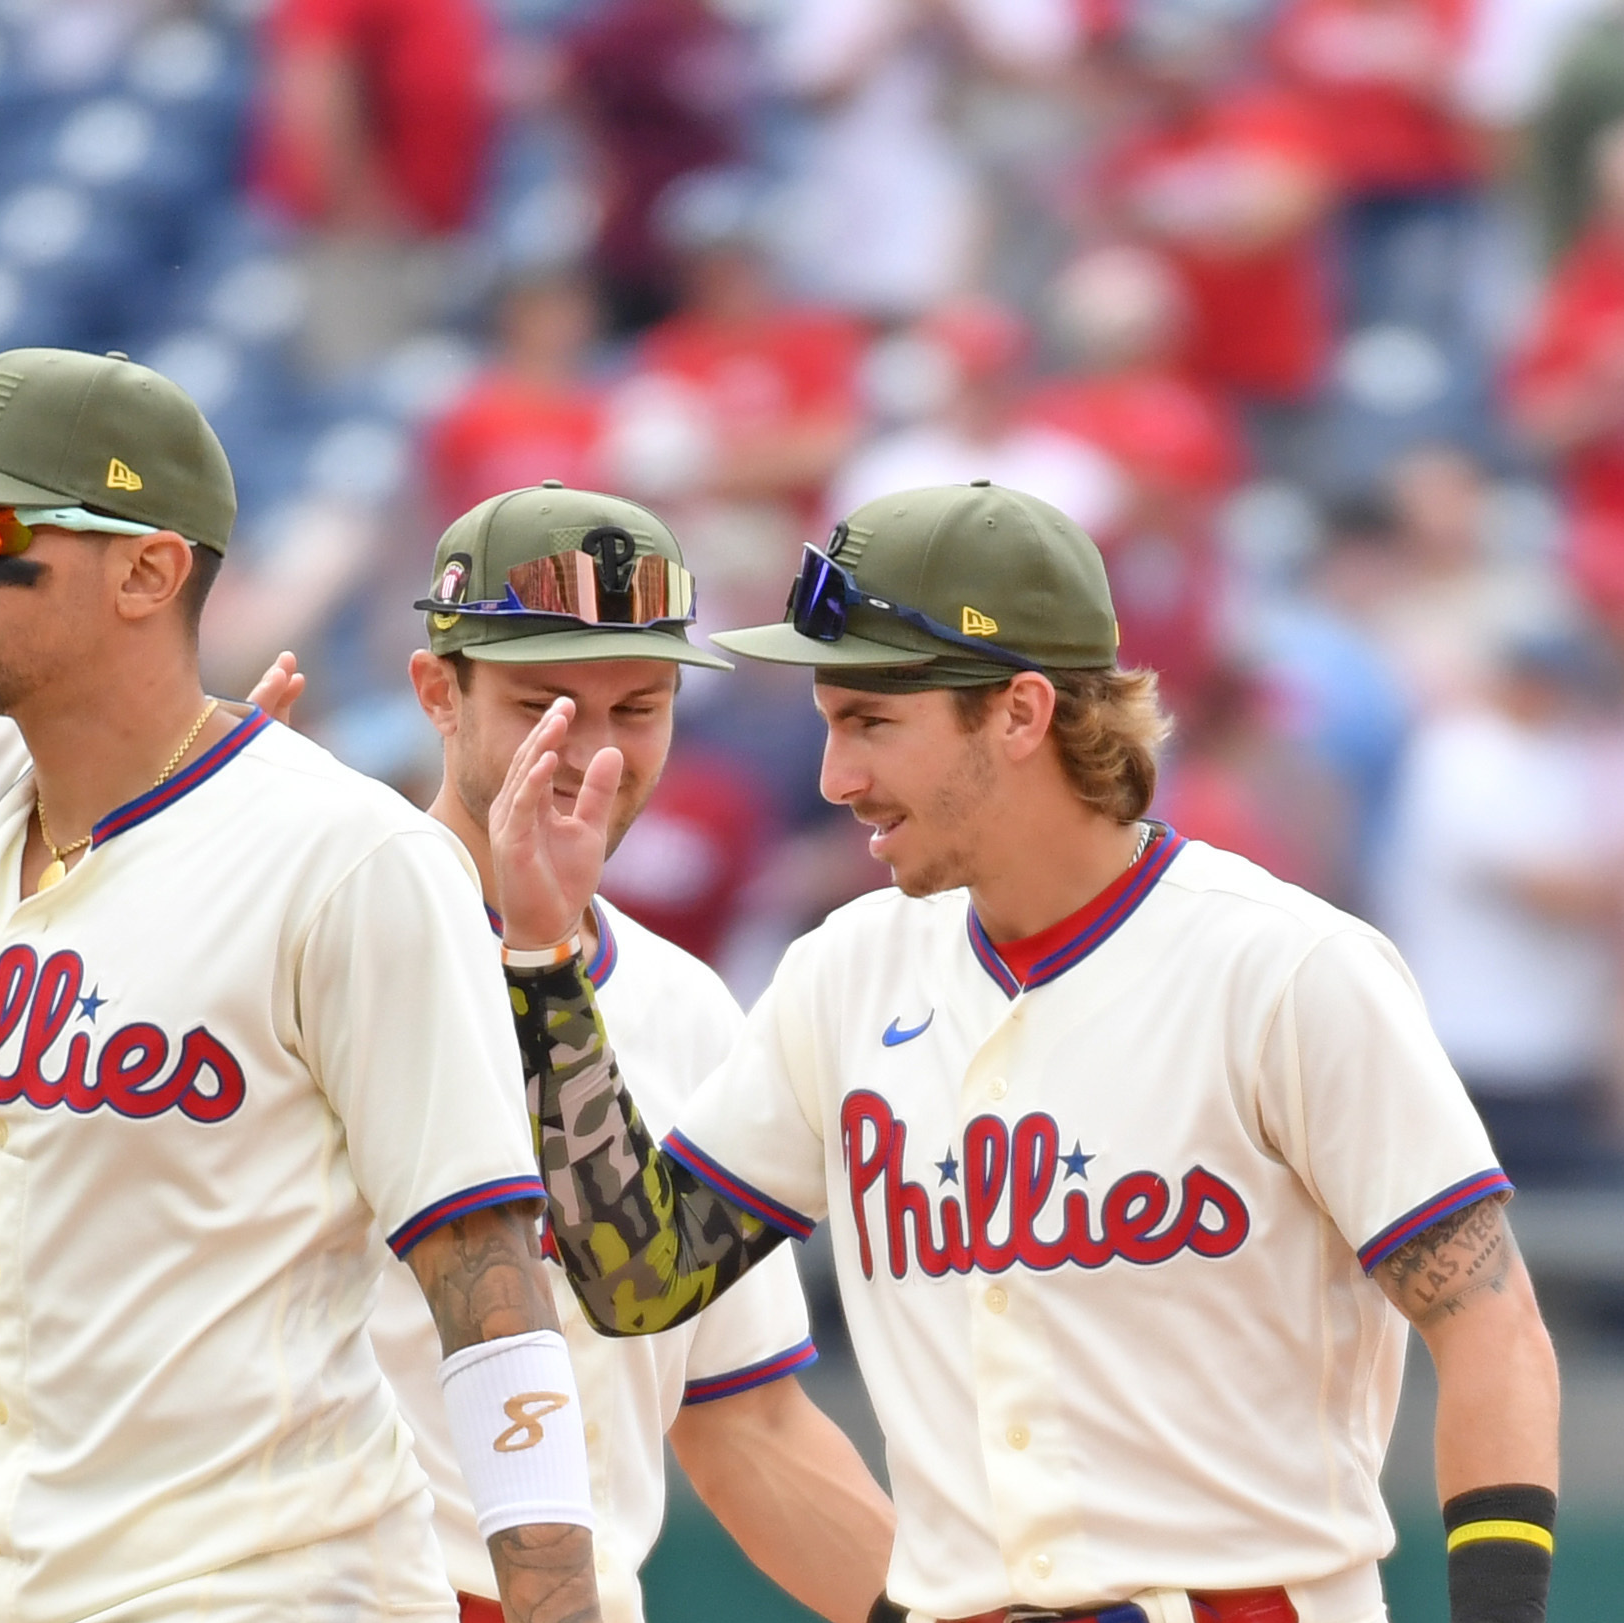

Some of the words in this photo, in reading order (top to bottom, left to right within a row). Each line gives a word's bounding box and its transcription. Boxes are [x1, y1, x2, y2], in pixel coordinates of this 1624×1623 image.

[840, 1088, 1250, 1281] Phillies
[1415, 1252, 1460, 1304] LAS
[492, 1391, 571, 1453] 8
